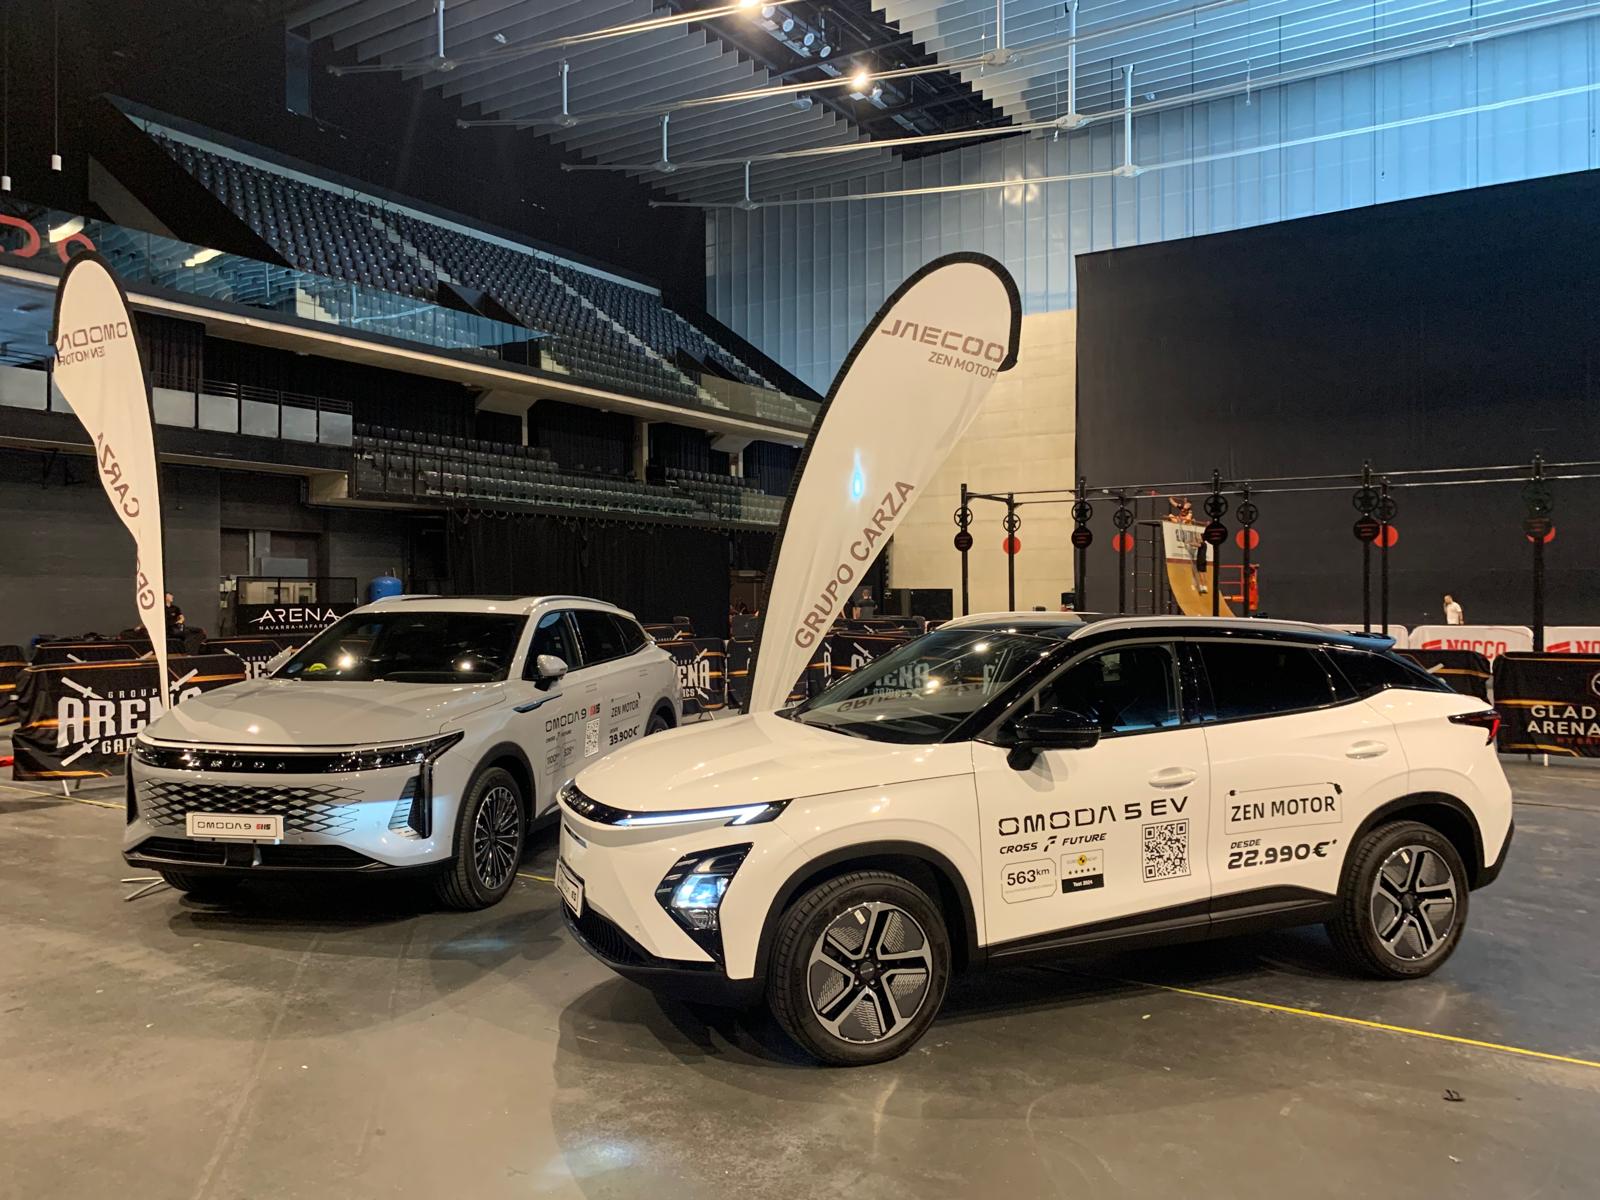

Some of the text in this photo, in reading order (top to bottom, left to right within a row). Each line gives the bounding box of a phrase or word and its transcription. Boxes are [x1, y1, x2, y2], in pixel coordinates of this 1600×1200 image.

[881, 320, 1005, 363] JAECOO
[928, 351, 998, 380] ZEN MOTOR
[794, 481, 915, 649] GRUPO CARZA
[259, 607, 339, 623] ARENA
[107, 687, 159, 699] GROUP
[1530, 704, 1597, 720] GLAD
[998, 796, 1188, 837] OMODA 5 EV
[1231, 795, 1336, 822] ZEN MOTOR
[999, 832, 1107, 855] CROSS FUTURE
[1230, 838, 1262, 850] DESDE
